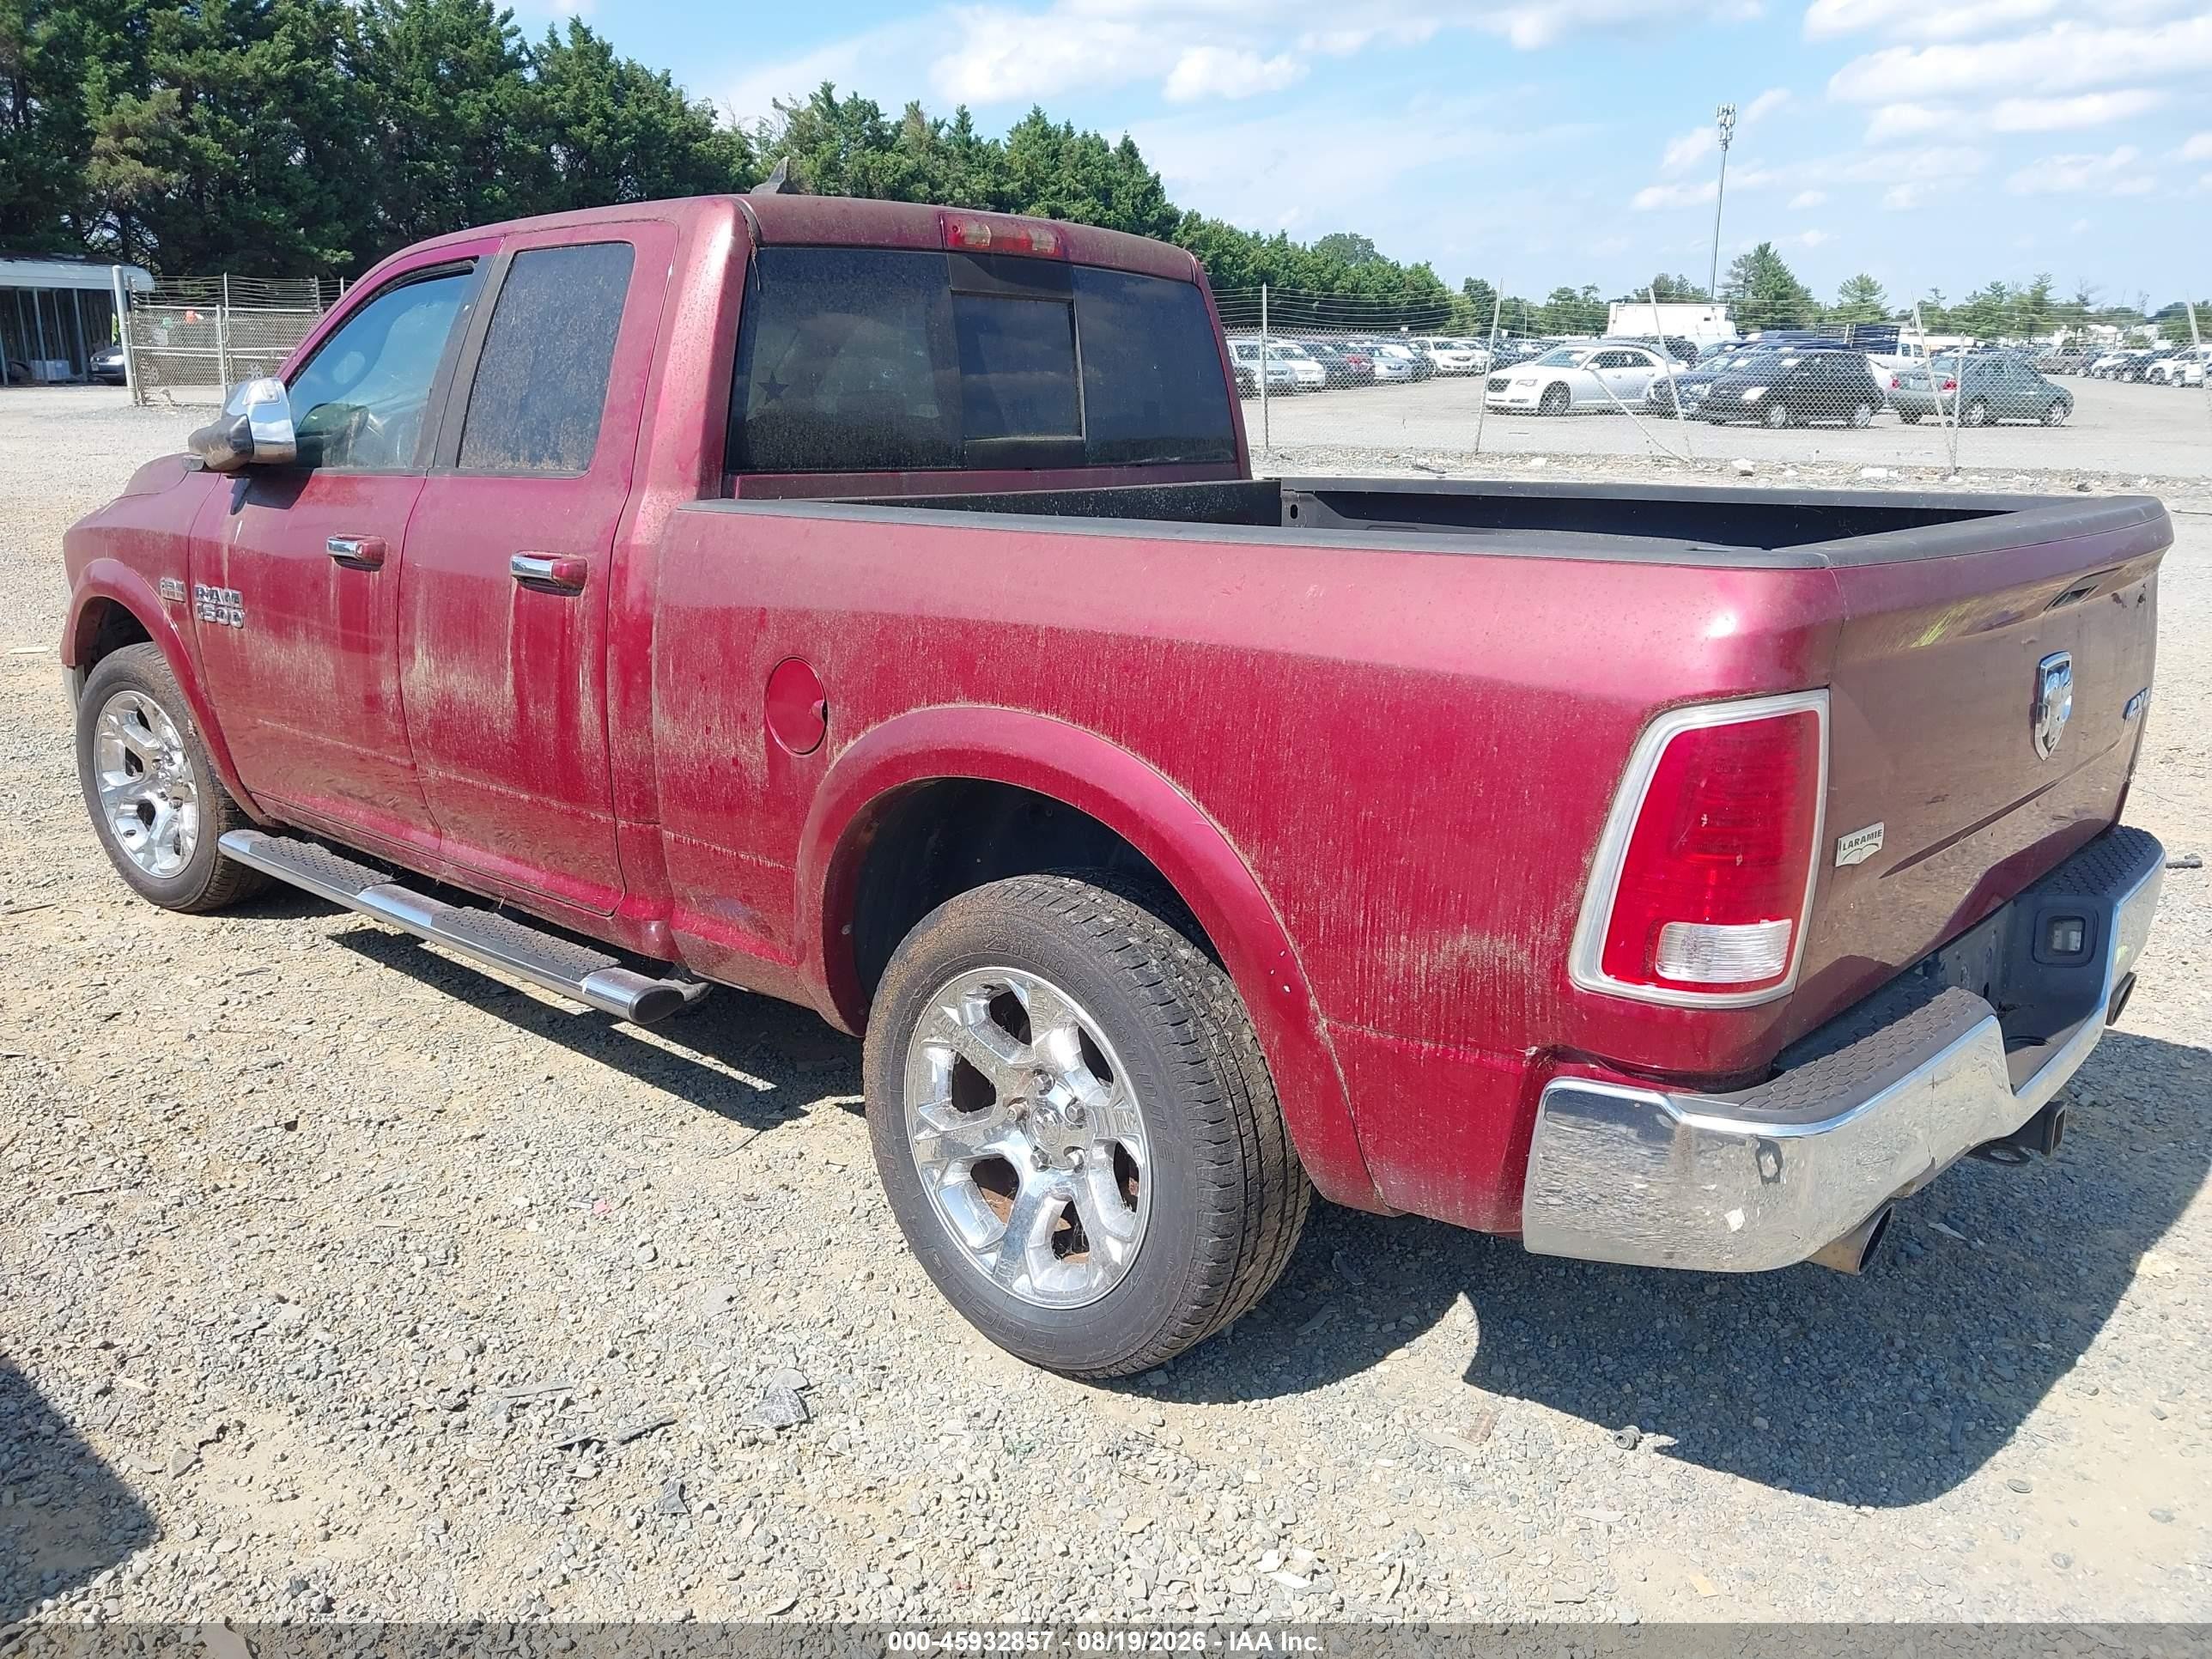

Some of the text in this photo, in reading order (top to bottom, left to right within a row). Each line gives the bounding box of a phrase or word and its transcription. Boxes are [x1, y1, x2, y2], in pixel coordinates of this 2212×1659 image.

[194, 584, 243, 608] RAM
[197, 602, 244, 629] 1500
[1842, 829, 1883, 851] LARAMIE
